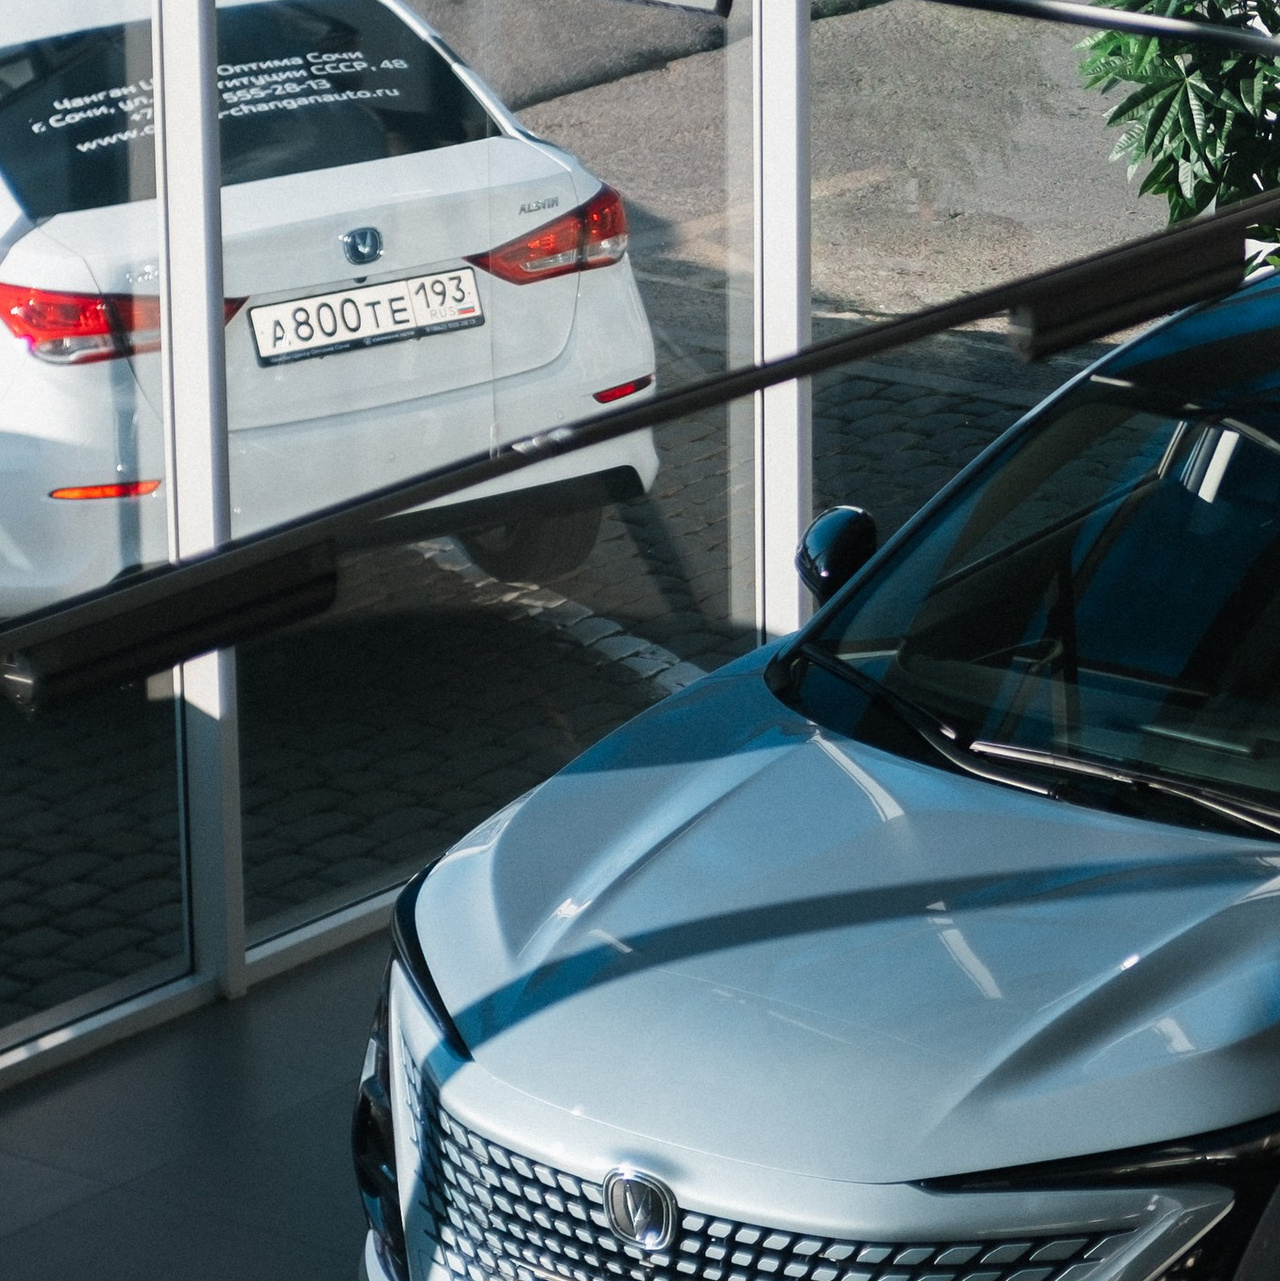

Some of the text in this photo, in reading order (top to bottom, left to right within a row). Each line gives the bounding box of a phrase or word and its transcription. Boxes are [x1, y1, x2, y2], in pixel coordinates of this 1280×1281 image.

[380, 58, 409, 69] 48
[53, 84, 137, 110] Чанган
[217, 56, 303, 76] Оптима
[306, 51, 364, 63] Сочи
[222, 78, 331, 104] 555-28-13
[415, 274, 466, 309] 193
[429, 305, 456, 319] RUS
